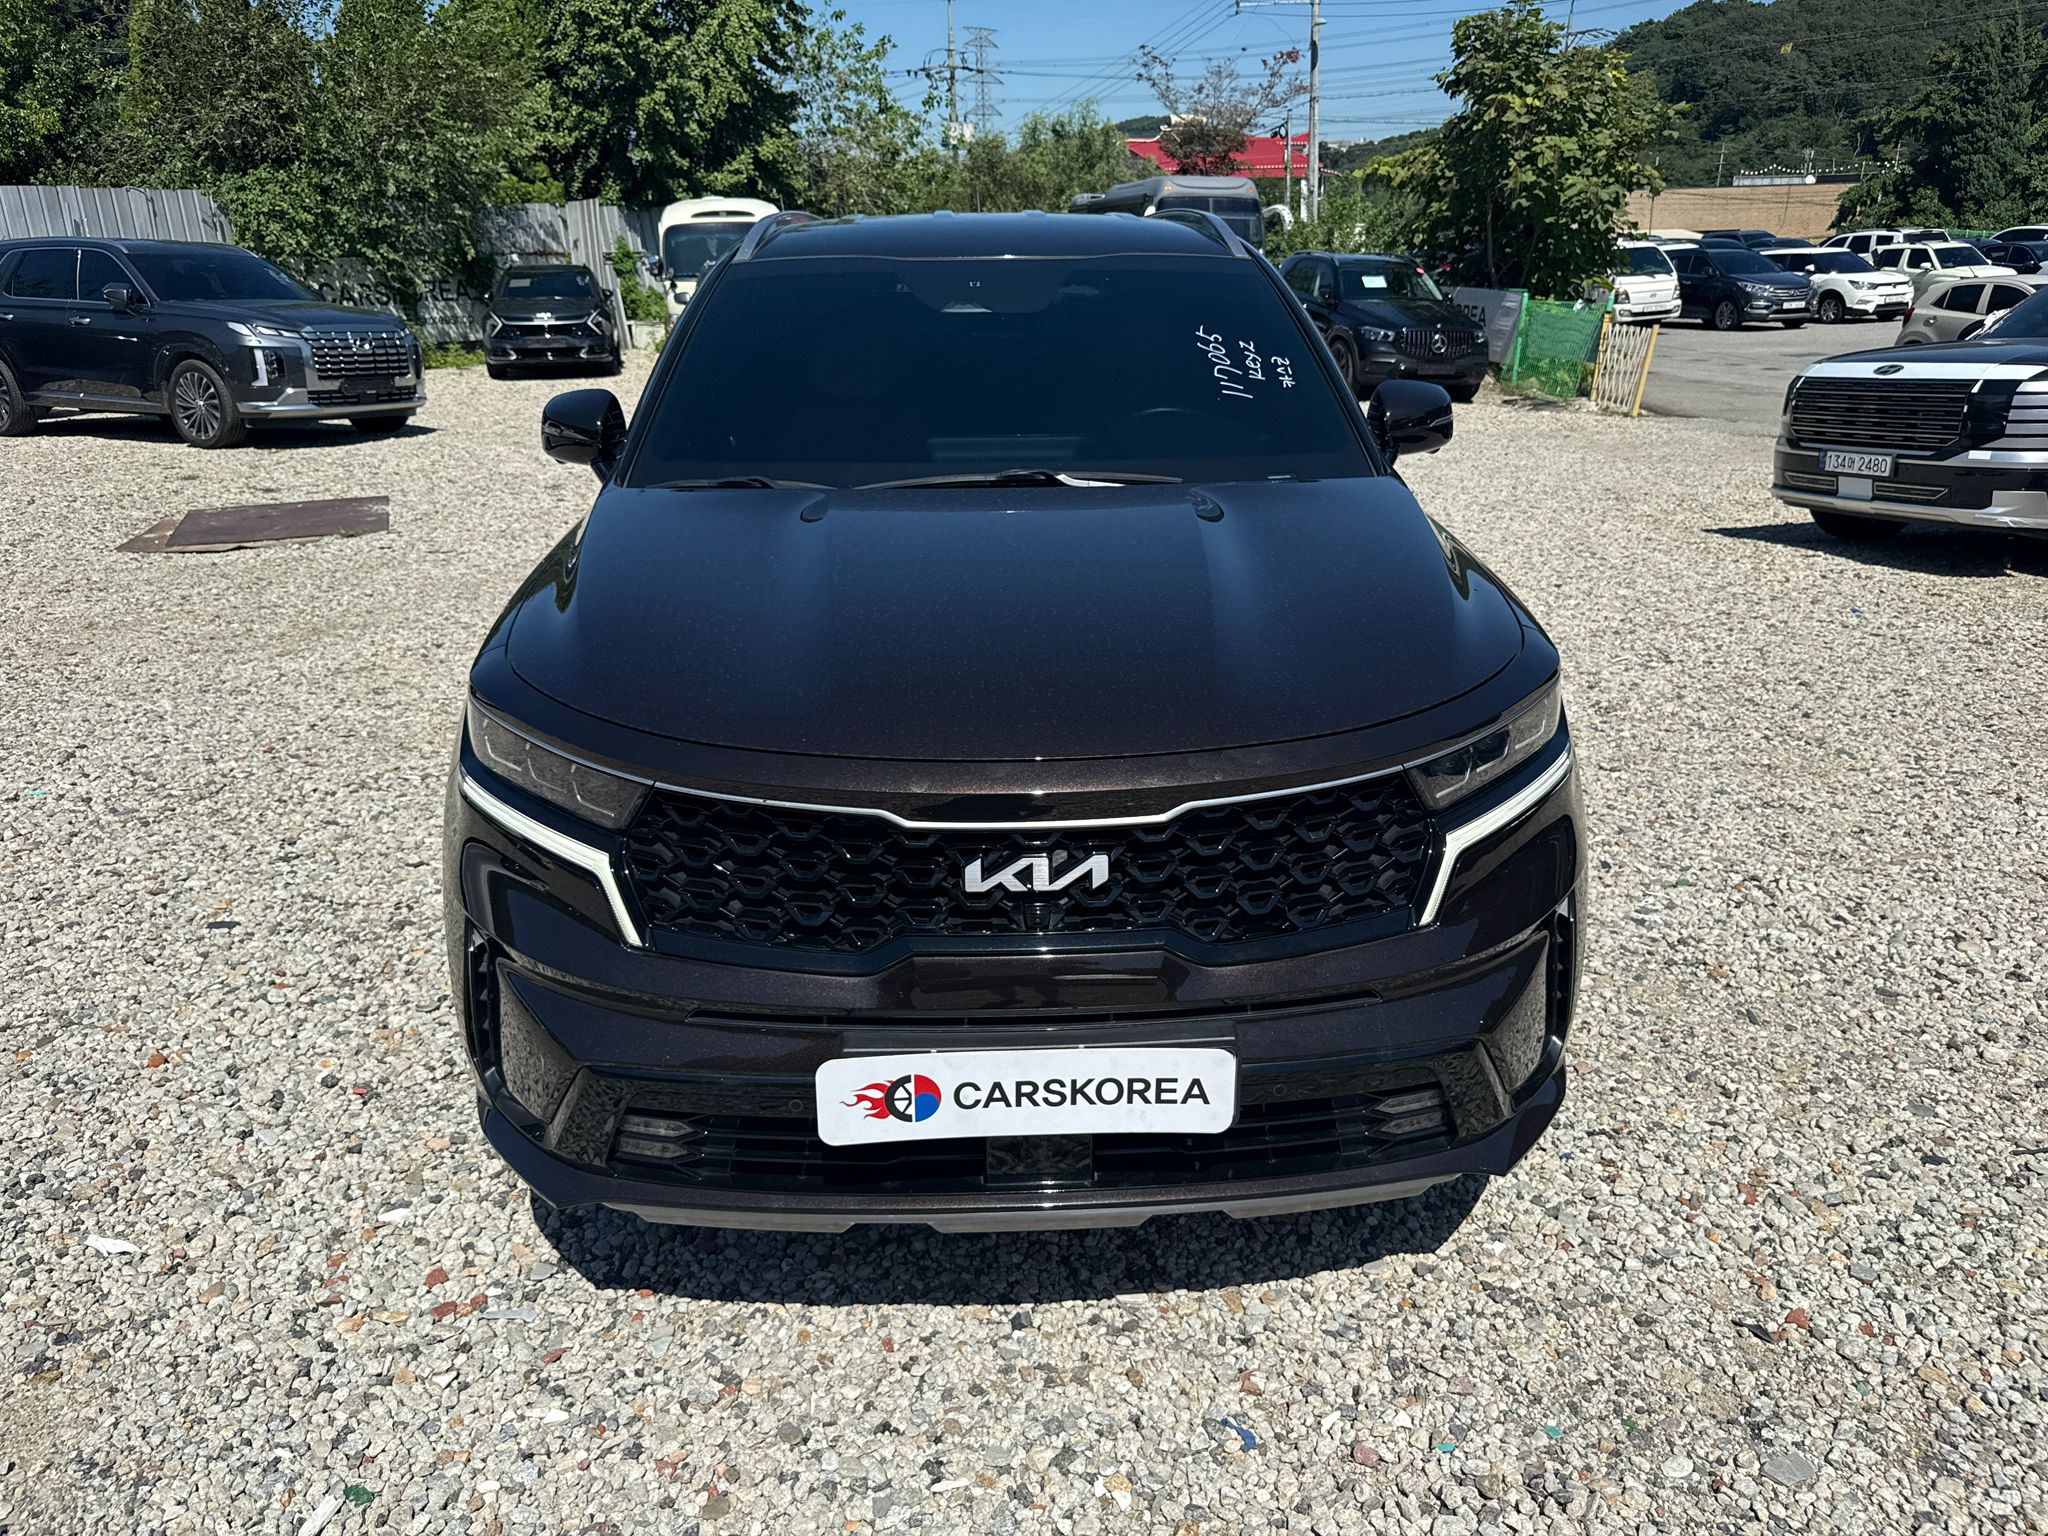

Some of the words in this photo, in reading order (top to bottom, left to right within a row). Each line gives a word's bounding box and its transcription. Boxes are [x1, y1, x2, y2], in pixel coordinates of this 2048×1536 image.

[318, 280, 472, 307] CARSREA
[1195, 325, 1254, 399] 117065
[1858, 456, 1888, 474] 2480
[964, 854, 1109, 893] KIA
[953, 1077, 1211, 1110] CARSKOREA
